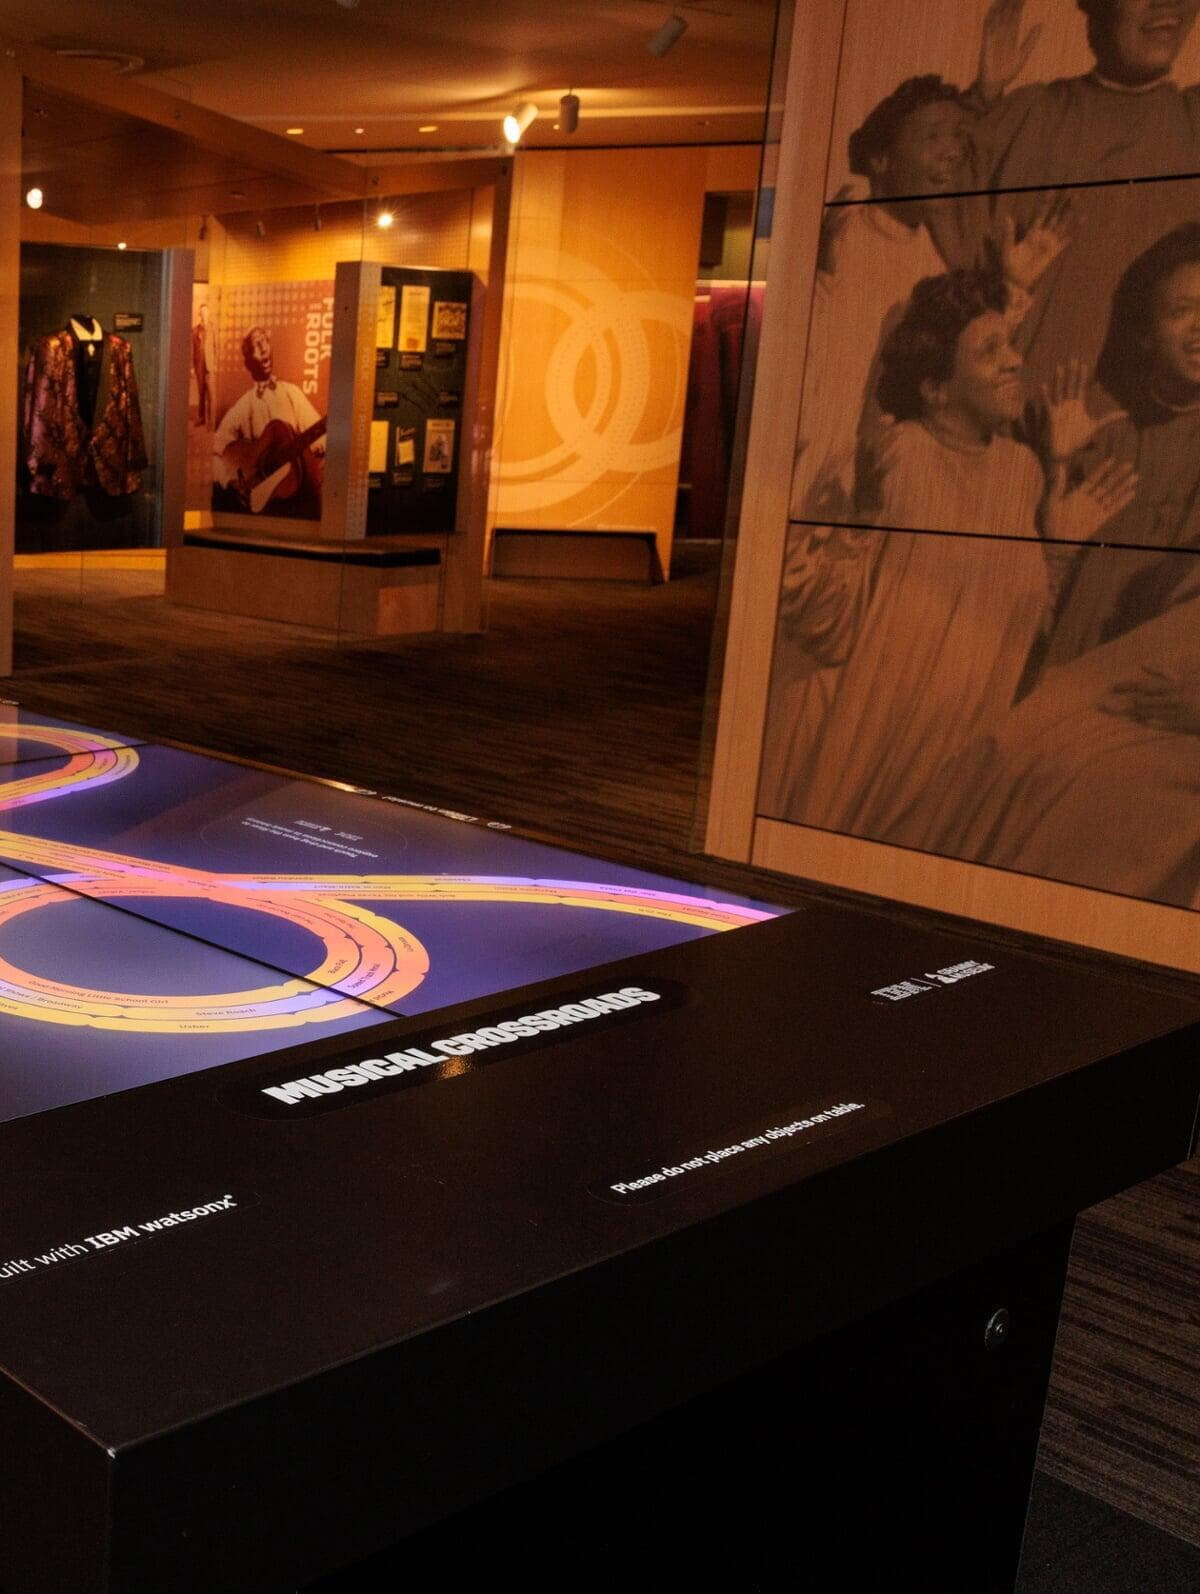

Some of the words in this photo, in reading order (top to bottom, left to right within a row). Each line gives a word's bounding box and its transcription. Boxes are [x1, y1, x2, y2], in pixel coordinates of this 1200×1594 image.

[302, 312, 322, 395] ROOTS
[261, 1047, 450, 1105] MUSICAL
[430, 987, 661, 1057] CROSSROADS
[610, 1172, 666, 1194] Please
[662, 1164, 686, 1178] do
[680, 1156, 711, 1171] not
[704, 1144, 745, 1164] place
[741, 1135, 771, 1149] any
[764, 1118, 815, 1141] objects
[810, 1113, 830, 1125] on
[824, 1101, 865, 1118] table.
[34, 1240, 89, 1265] with
[84, 1226, 141, 1249] IBM
